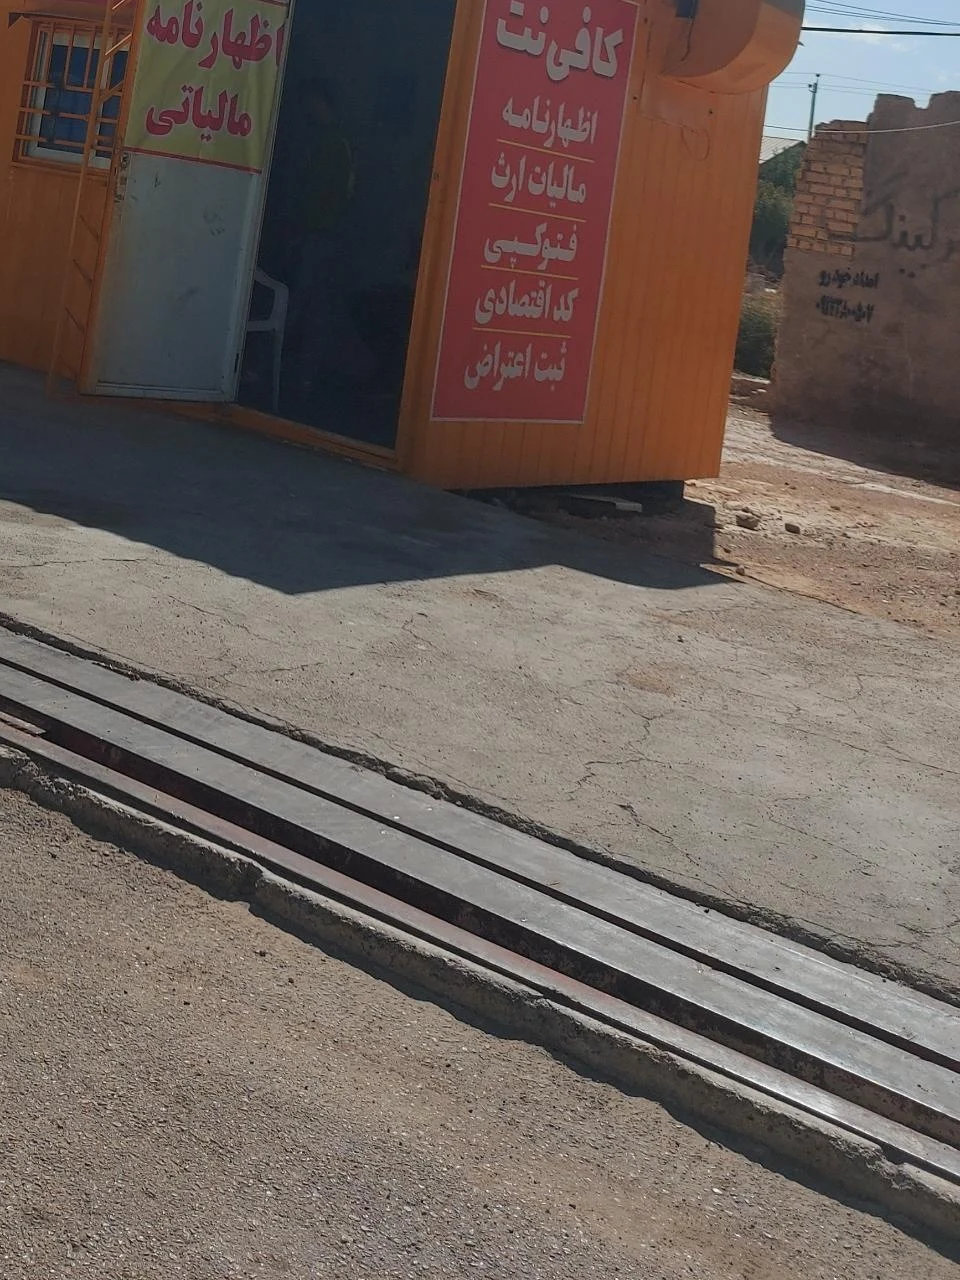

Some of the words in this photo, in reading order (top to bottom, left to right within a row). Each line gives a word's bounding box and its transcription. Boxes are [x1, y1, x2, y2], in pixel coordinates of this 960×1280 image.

[146, 84, 252, 141] مالیاتی
[502, 95, 598, 147] اظهارنامه
[491, 152, 527, 202] ارث
[528, 162, 586, 208] مالیات
[484, 223, 578, 271] فتوکپی
[475, 279, 553, 325] اقتصادی
[553, 287, 580, 322] کد
[464, 340, 533, 391] اعتراض
[534, 341, 568, 391] ثبت
